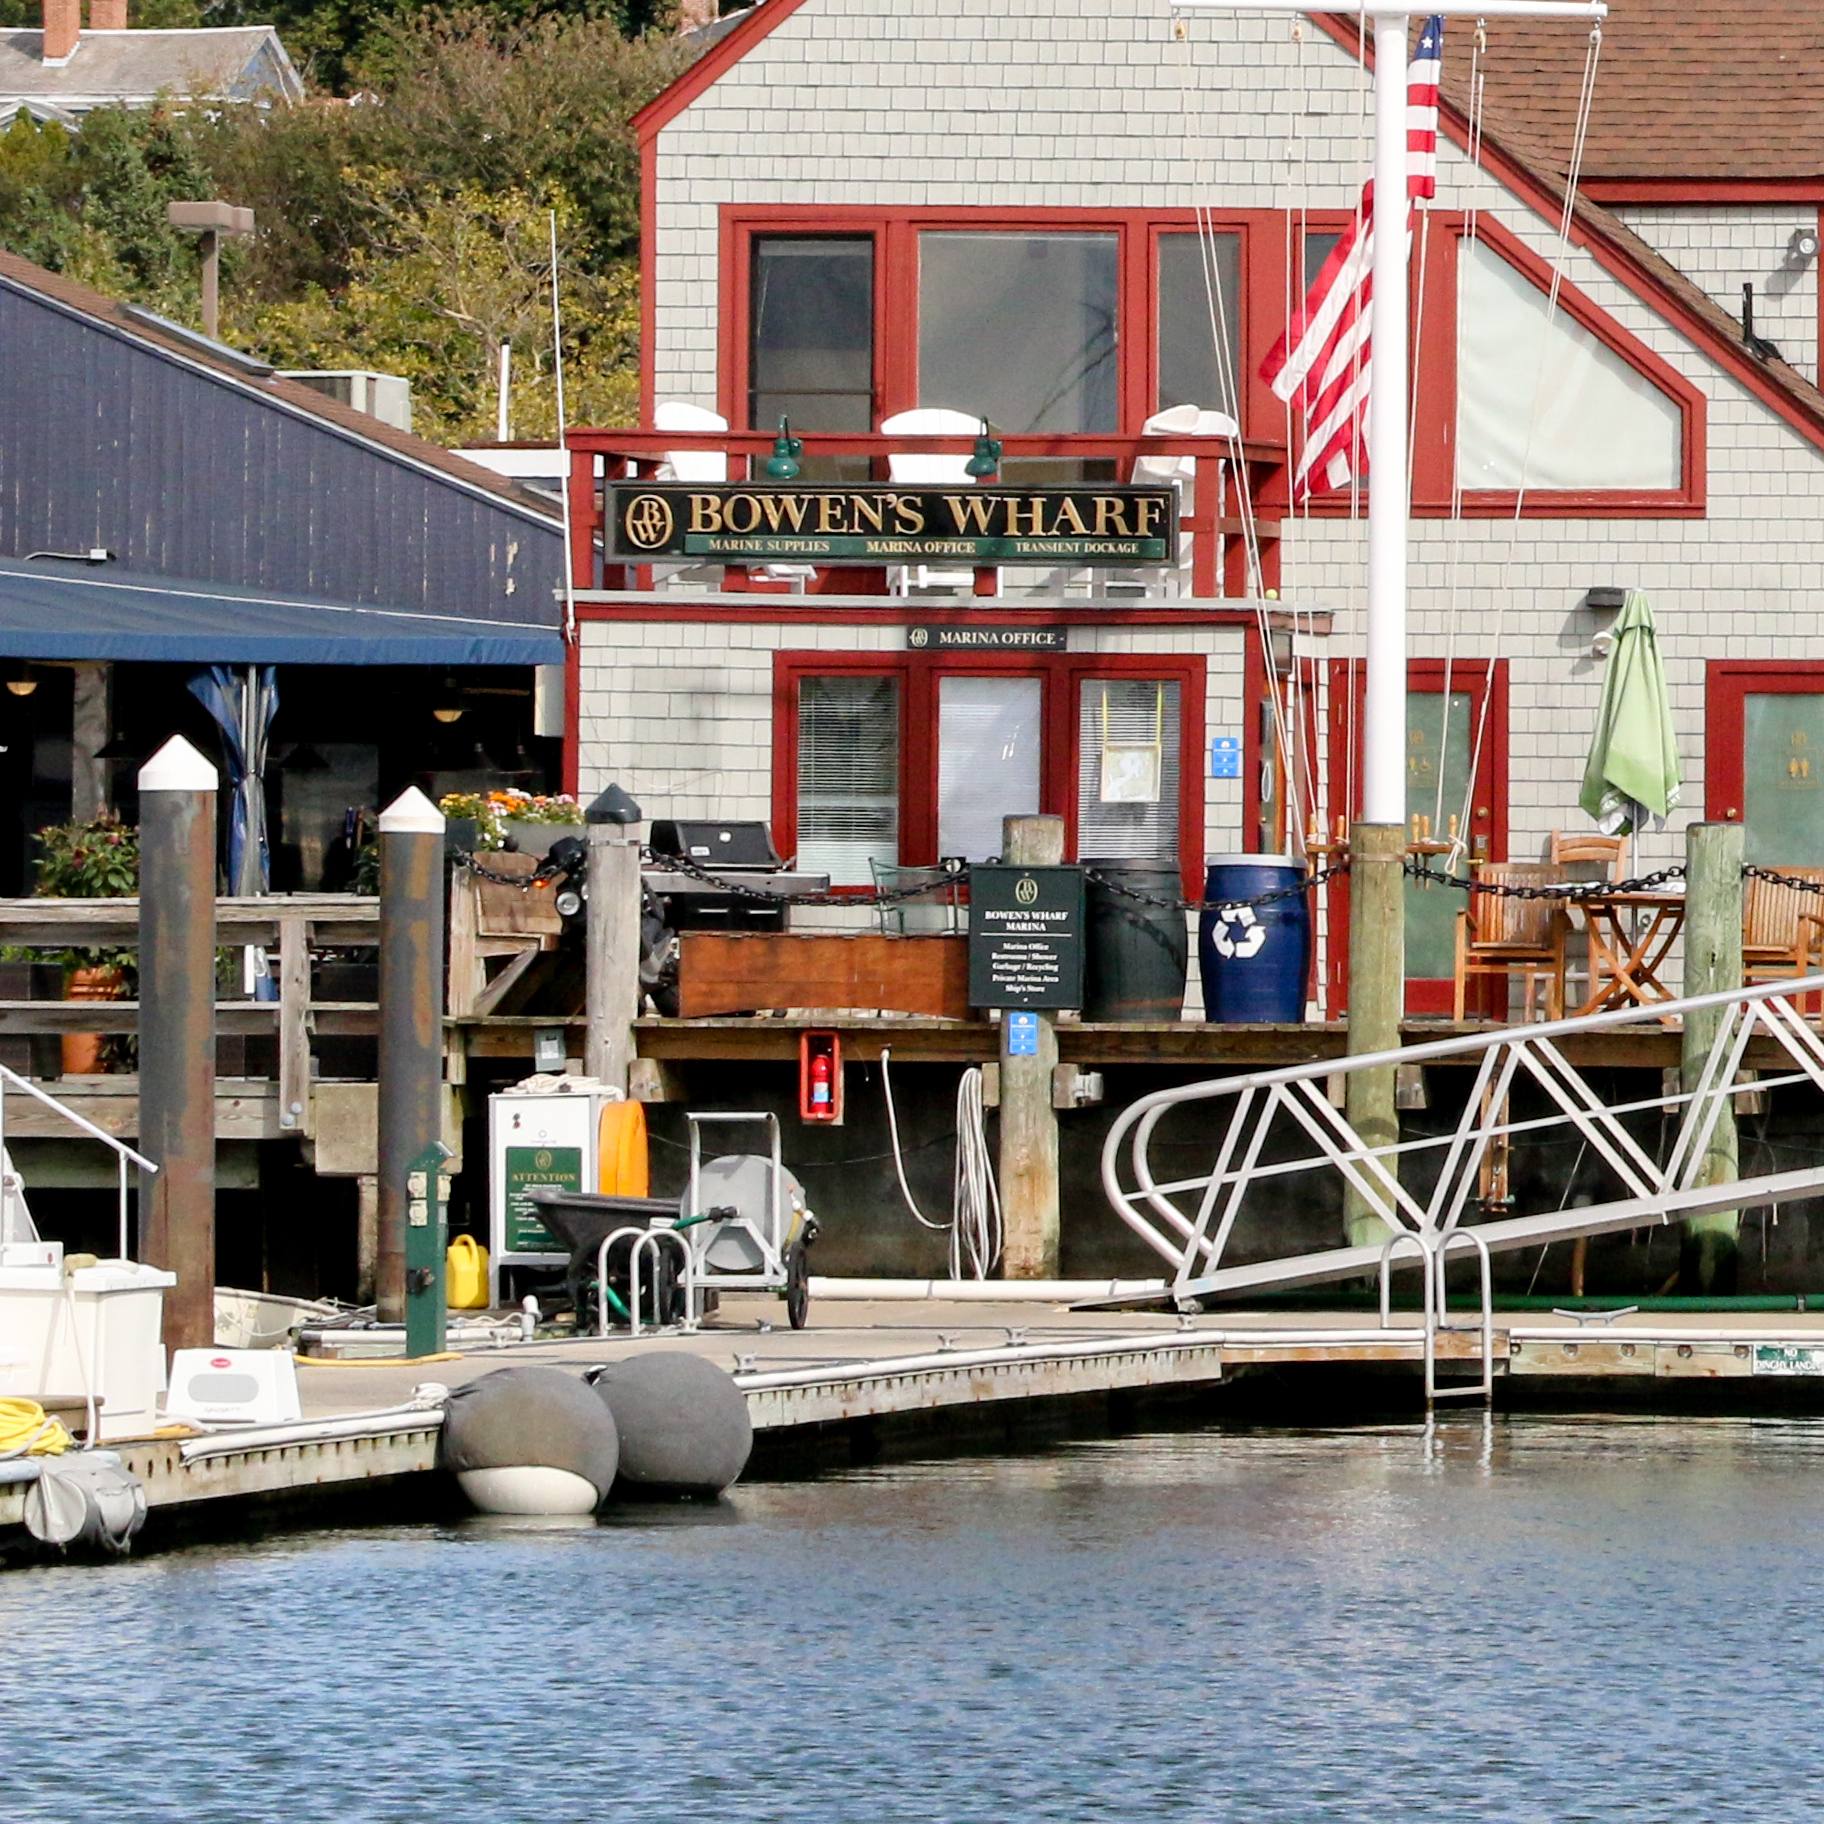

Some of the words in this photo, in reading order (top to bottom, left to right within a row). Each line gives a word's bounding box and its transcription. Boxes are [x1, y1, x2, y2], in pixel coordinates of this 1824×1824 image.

[687, 494, 925, 535] BOWEN'S
[942, 495, 1165, 537] WHARF
[708, 539, 763, 551] MARINE
[766, 540, 830, 552] SUPPLIES
[866, 540, 921, 552] MARINA
[924, 542, 976, 554] OFFICE
[1016, 542, 1080, 553] TRANSIENT
[1083, 543, 1139, 554] DOCKAGE
[939, 631, 999, 644] MARINA
[1001, 632, 1056, 645] OFFICE
[985, 911, 1030, 920] BOWEN'S
[1031, 911, 1069, 921] WHARF
[1005, 922, 1047, 931] MARINA
[511, 1173, 576, 1182] ATTENTION
[1783, 1348, 1798, 1357] NO
